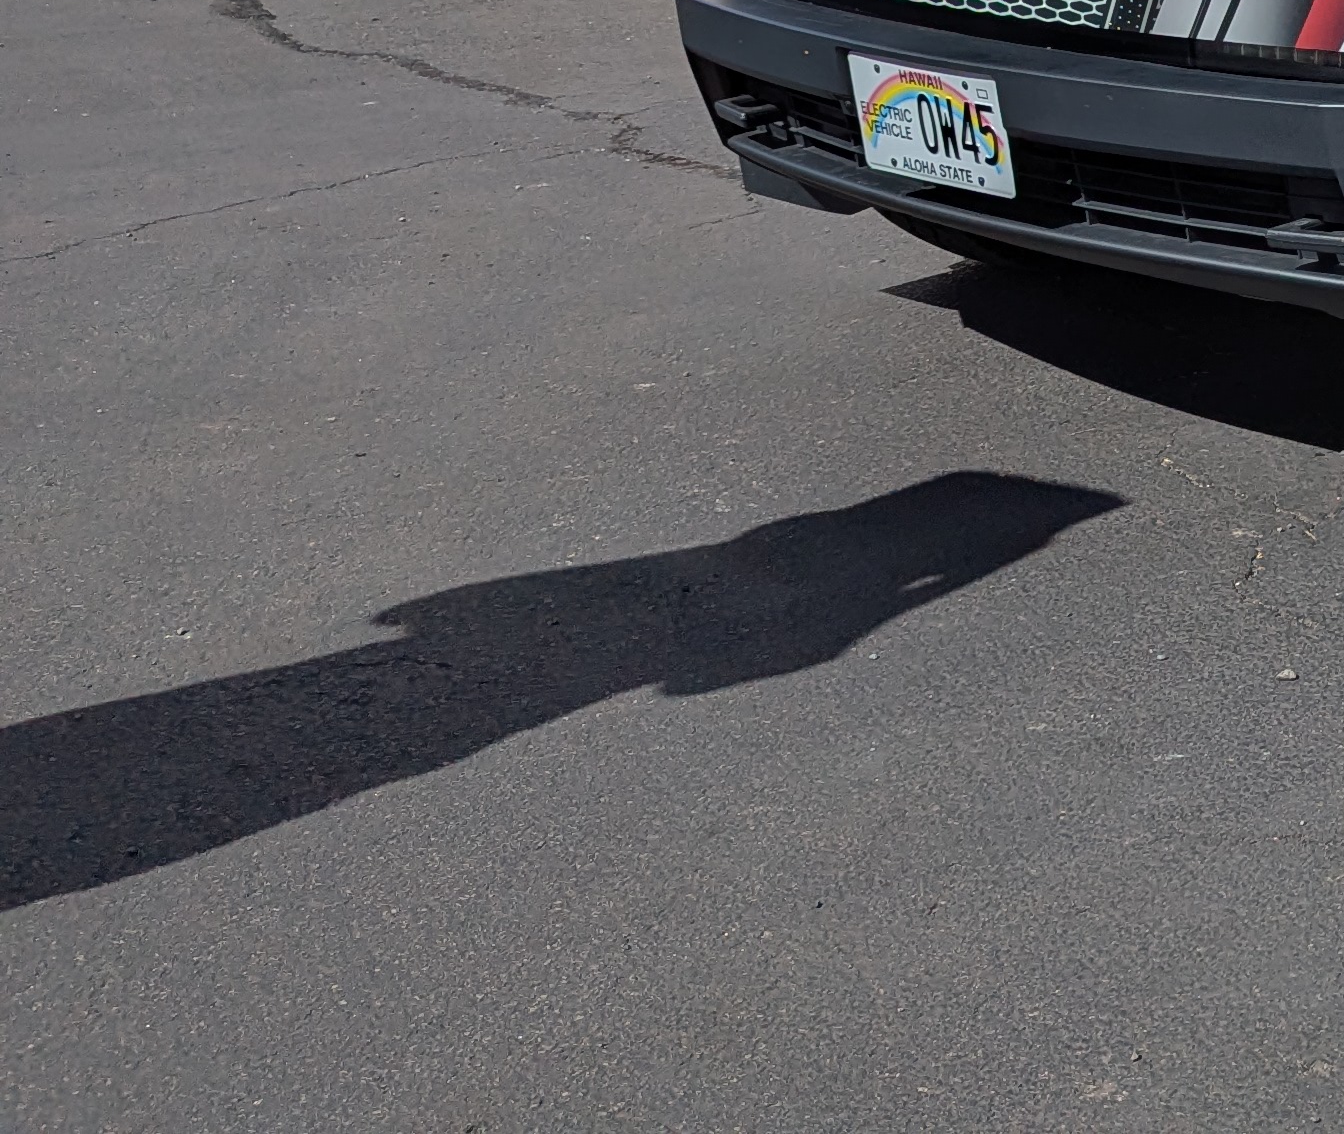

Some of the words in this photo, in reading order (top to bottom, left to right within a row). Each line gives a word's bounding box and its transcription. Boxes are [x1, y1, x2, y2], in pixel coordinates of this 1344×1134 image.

[898, 69, 944, 91] HAWAII
[860, 100, 913, 123] ELECTRIC
[866, 119, 913, 140] VEHICLE
[903, 156, 936, 178] ALOHA
[939, 164, 974, 183] STATE
